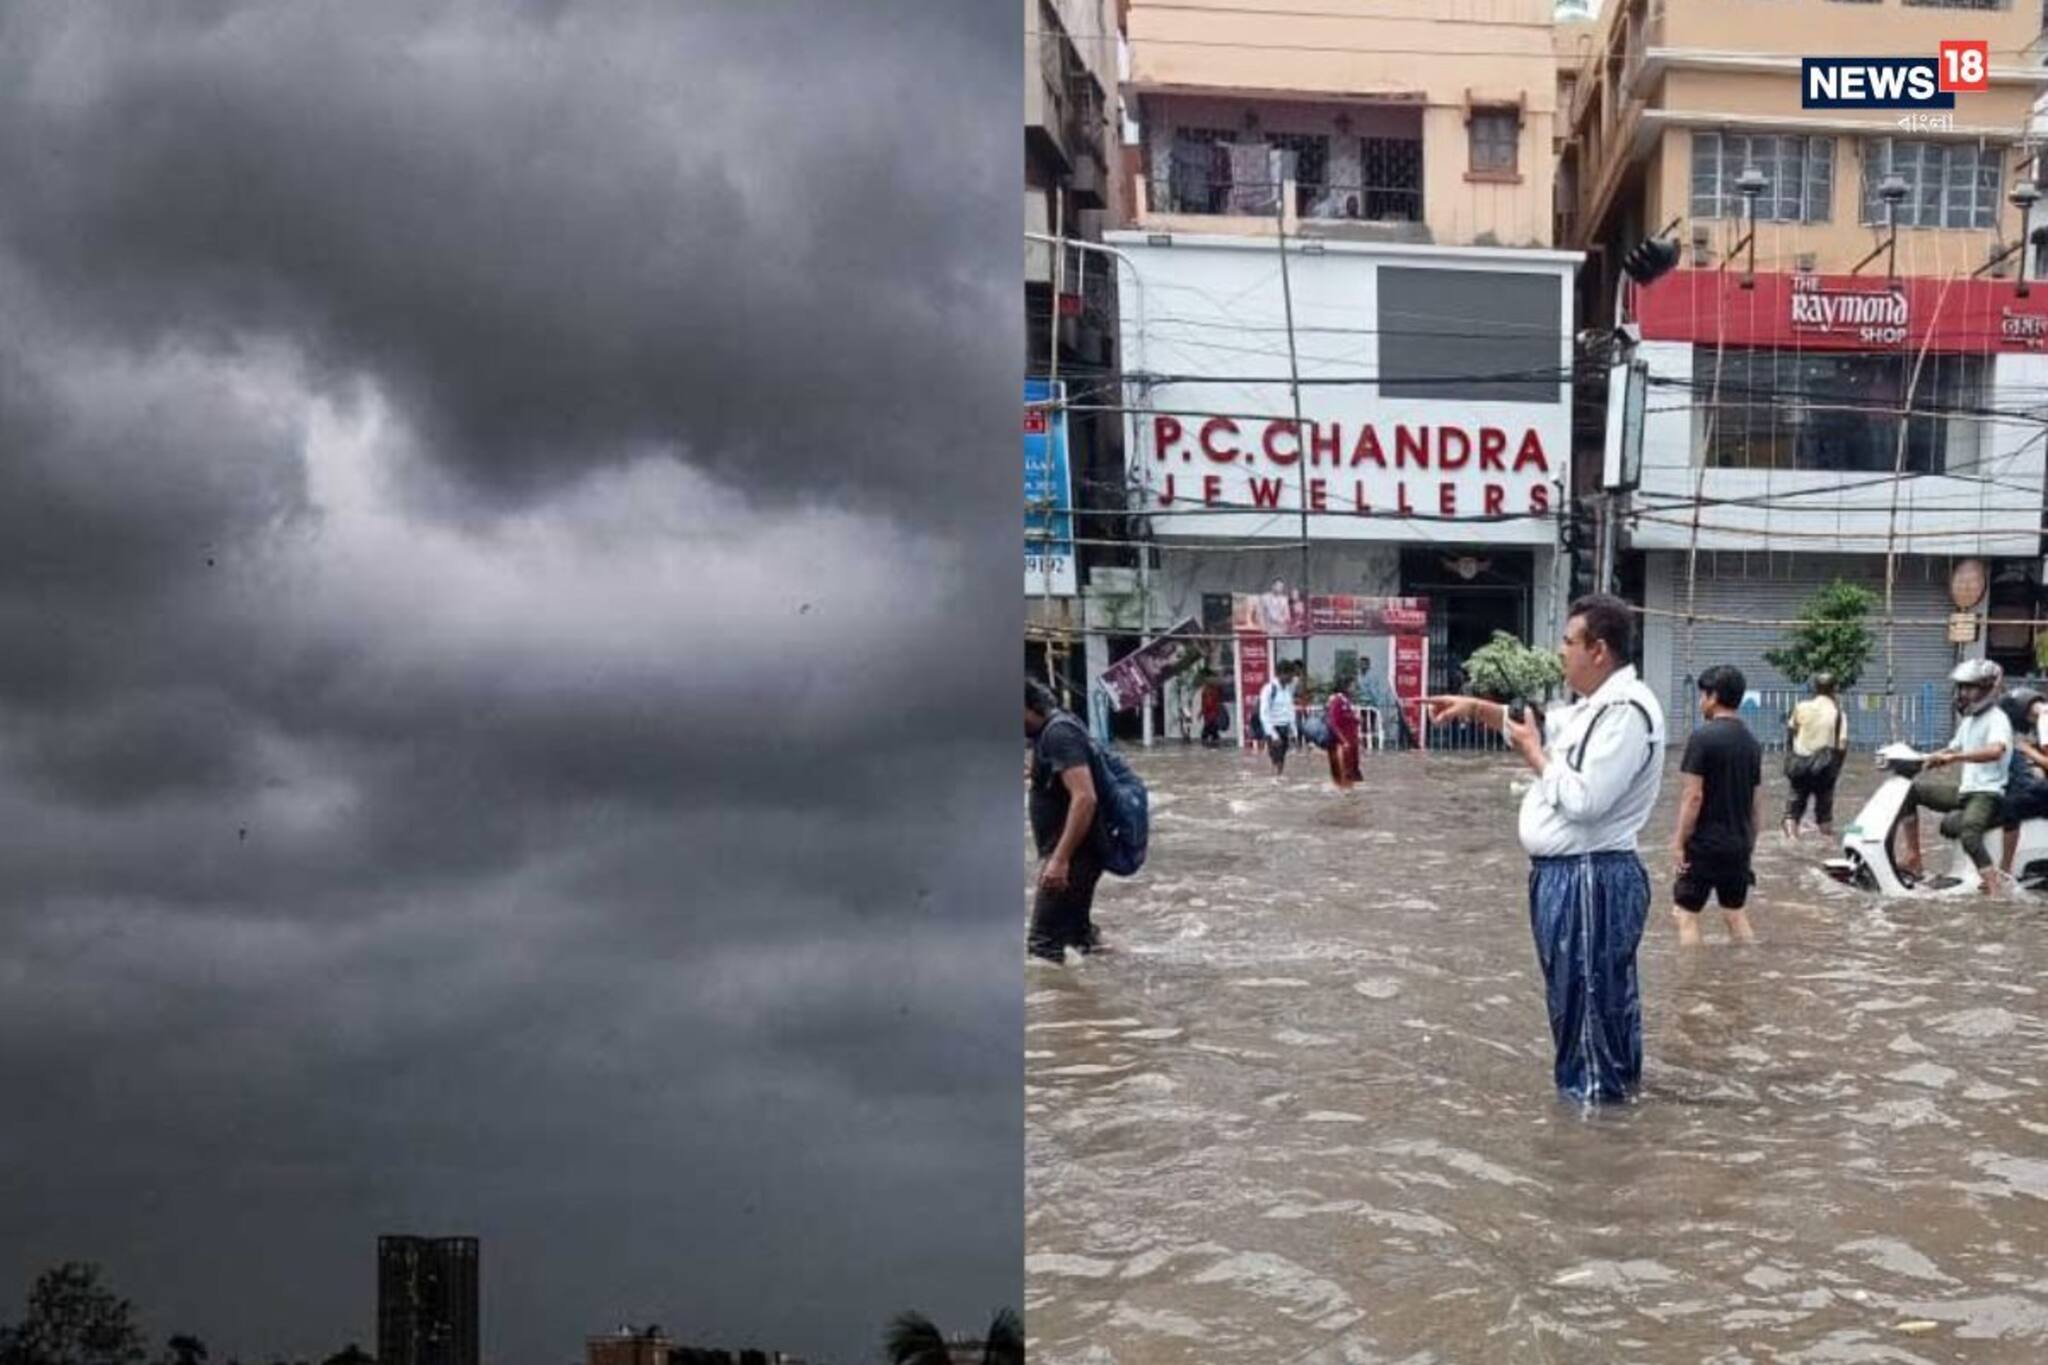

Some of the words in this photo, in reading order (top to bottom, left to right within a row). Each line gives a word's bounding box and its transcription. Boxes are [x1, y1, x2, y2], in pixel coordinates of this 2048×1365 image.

[1793, 276, 1820, 290] THE
[1791, 292, 1908, 332] Raymond
[1860, 327, 1906, 343] SHOP
[1157, 474, 1551, 518] JEWELLERS
